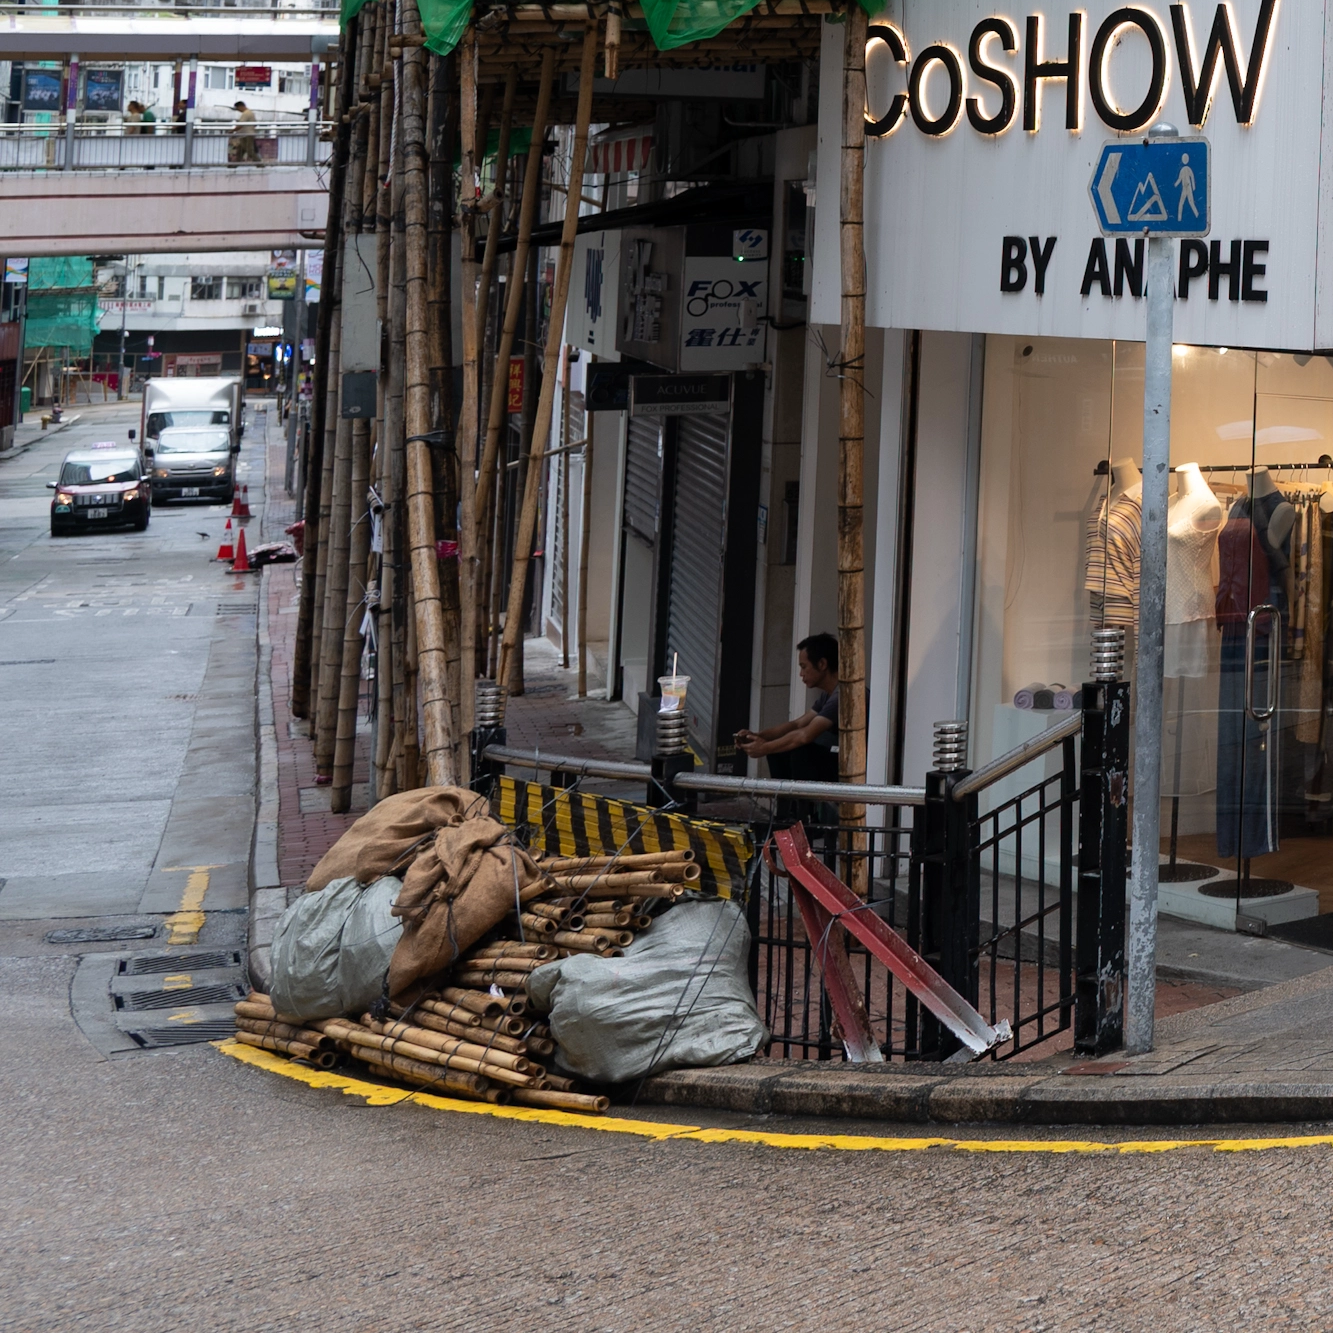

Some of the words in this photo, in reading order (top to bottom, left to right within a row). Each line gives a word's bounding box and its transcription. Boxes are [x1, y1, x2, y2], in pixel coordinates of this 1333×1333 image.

[1000, 236, 1058, 295] BY
[1080, 237, 1270, 302] ANPHE
[687, 279, 762, 300] FOX
[657, 384, 708, 395] ACUVUE
[660, 404, 720, 412] PROFESSIONAL
